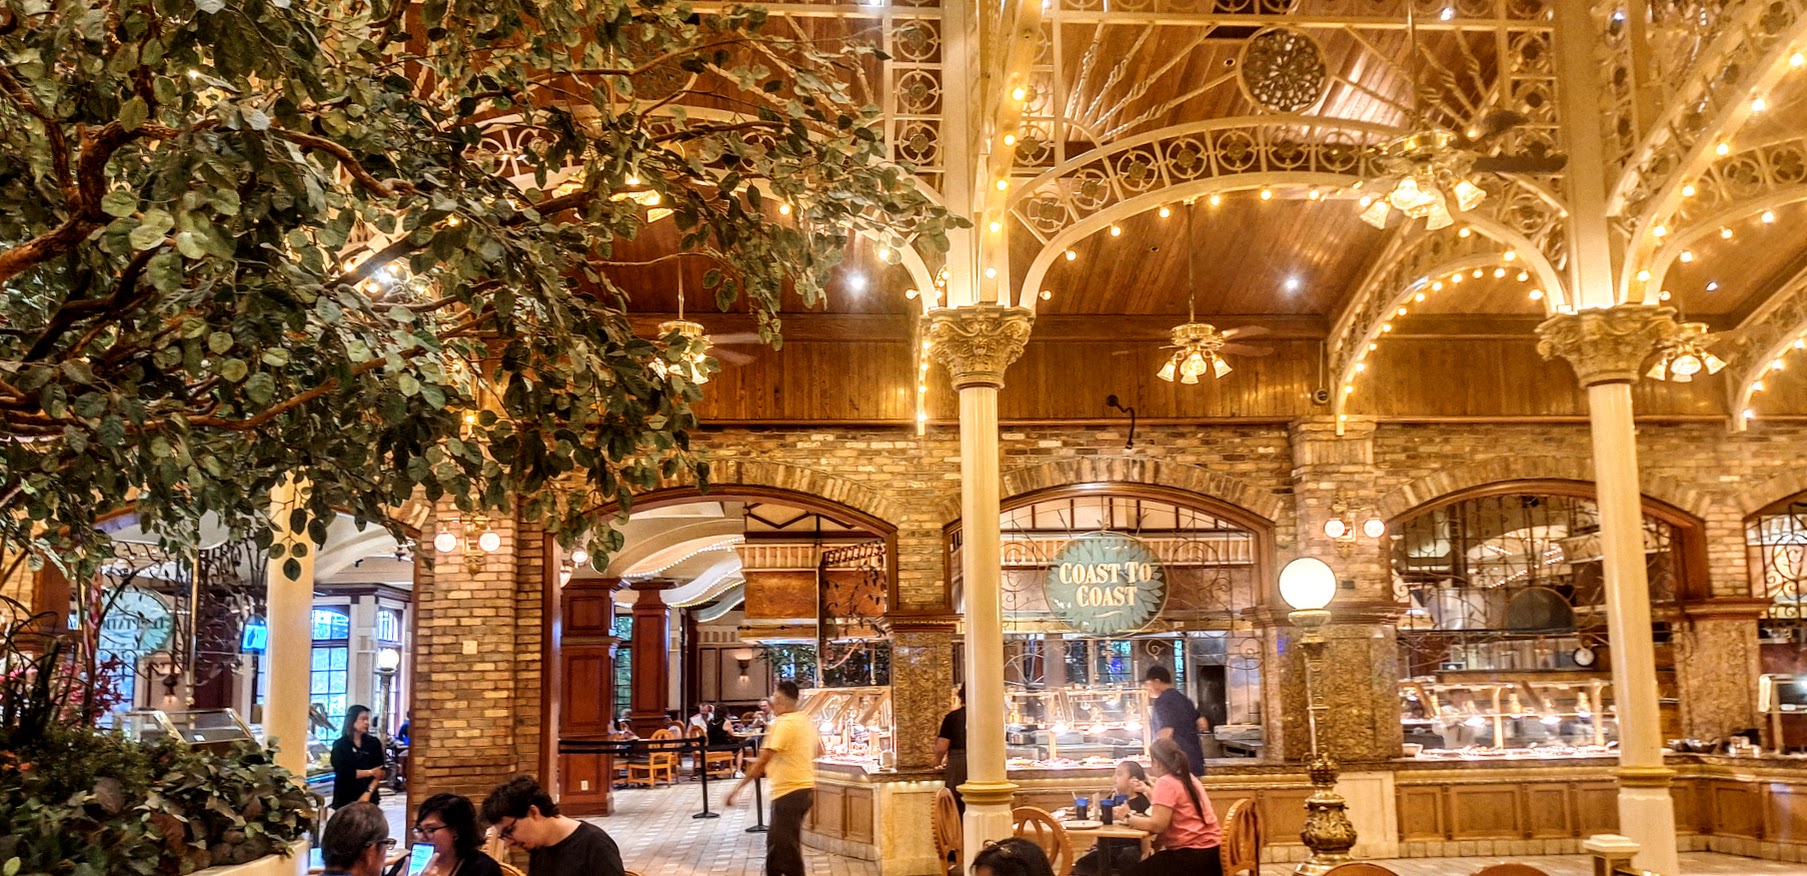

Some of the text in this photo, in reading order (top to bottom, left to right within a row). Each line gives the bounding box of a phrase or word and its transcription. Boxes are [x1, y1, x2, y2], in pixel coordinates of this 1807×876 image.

[1058, 561, 1152, 584] COAST TO
[1075, 585, 1138, 607] COAST
